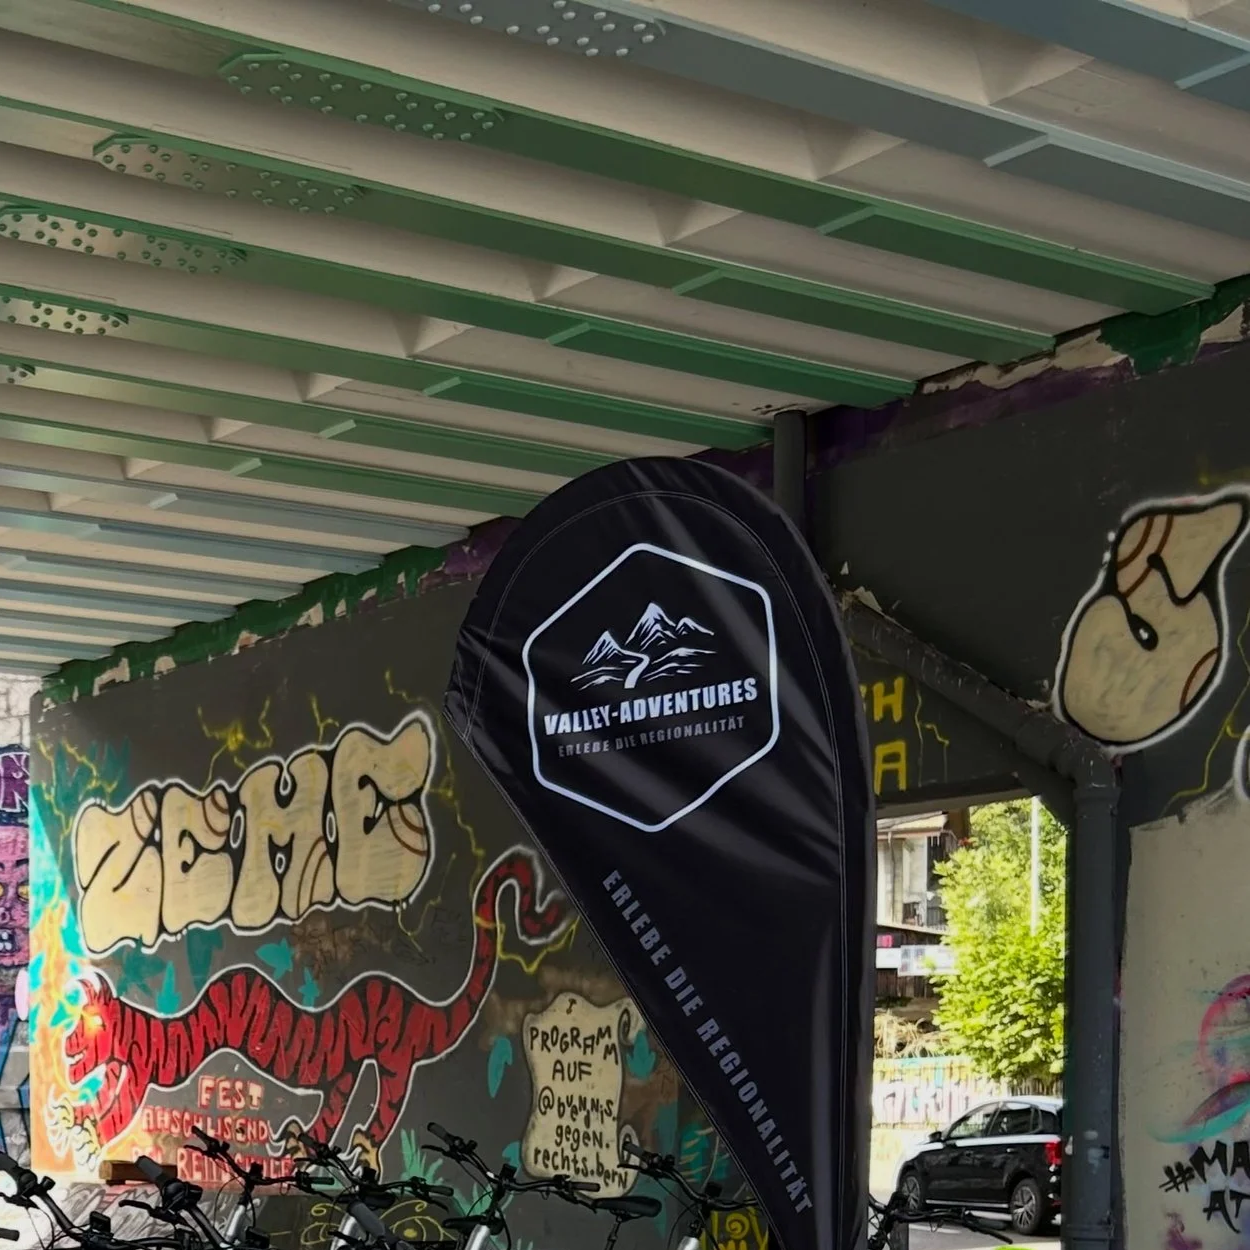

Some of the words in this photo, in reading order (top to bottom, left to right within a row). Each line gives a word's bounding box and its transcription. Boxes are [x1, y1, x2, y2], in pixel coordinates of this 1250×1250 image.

[544, 677, 758, 736] VALLEY-ADVENTURES
[558, 739, 610, 758] ERLEBE
[615, 735, 637, 750] DIE
[640, 715, 746, 746] REGIONALITÄT
[529, 1024, 619, 1066] PROGRAMM
[601, 869, 673, 966] ERLEBE
[664, 965, 703, 1018] DIE
[696, 1017, 814, 1215] REGIONALITÄT
[551, 1059, 593, 1083] AUF
[198, 1075, 266, 1111] FEST
